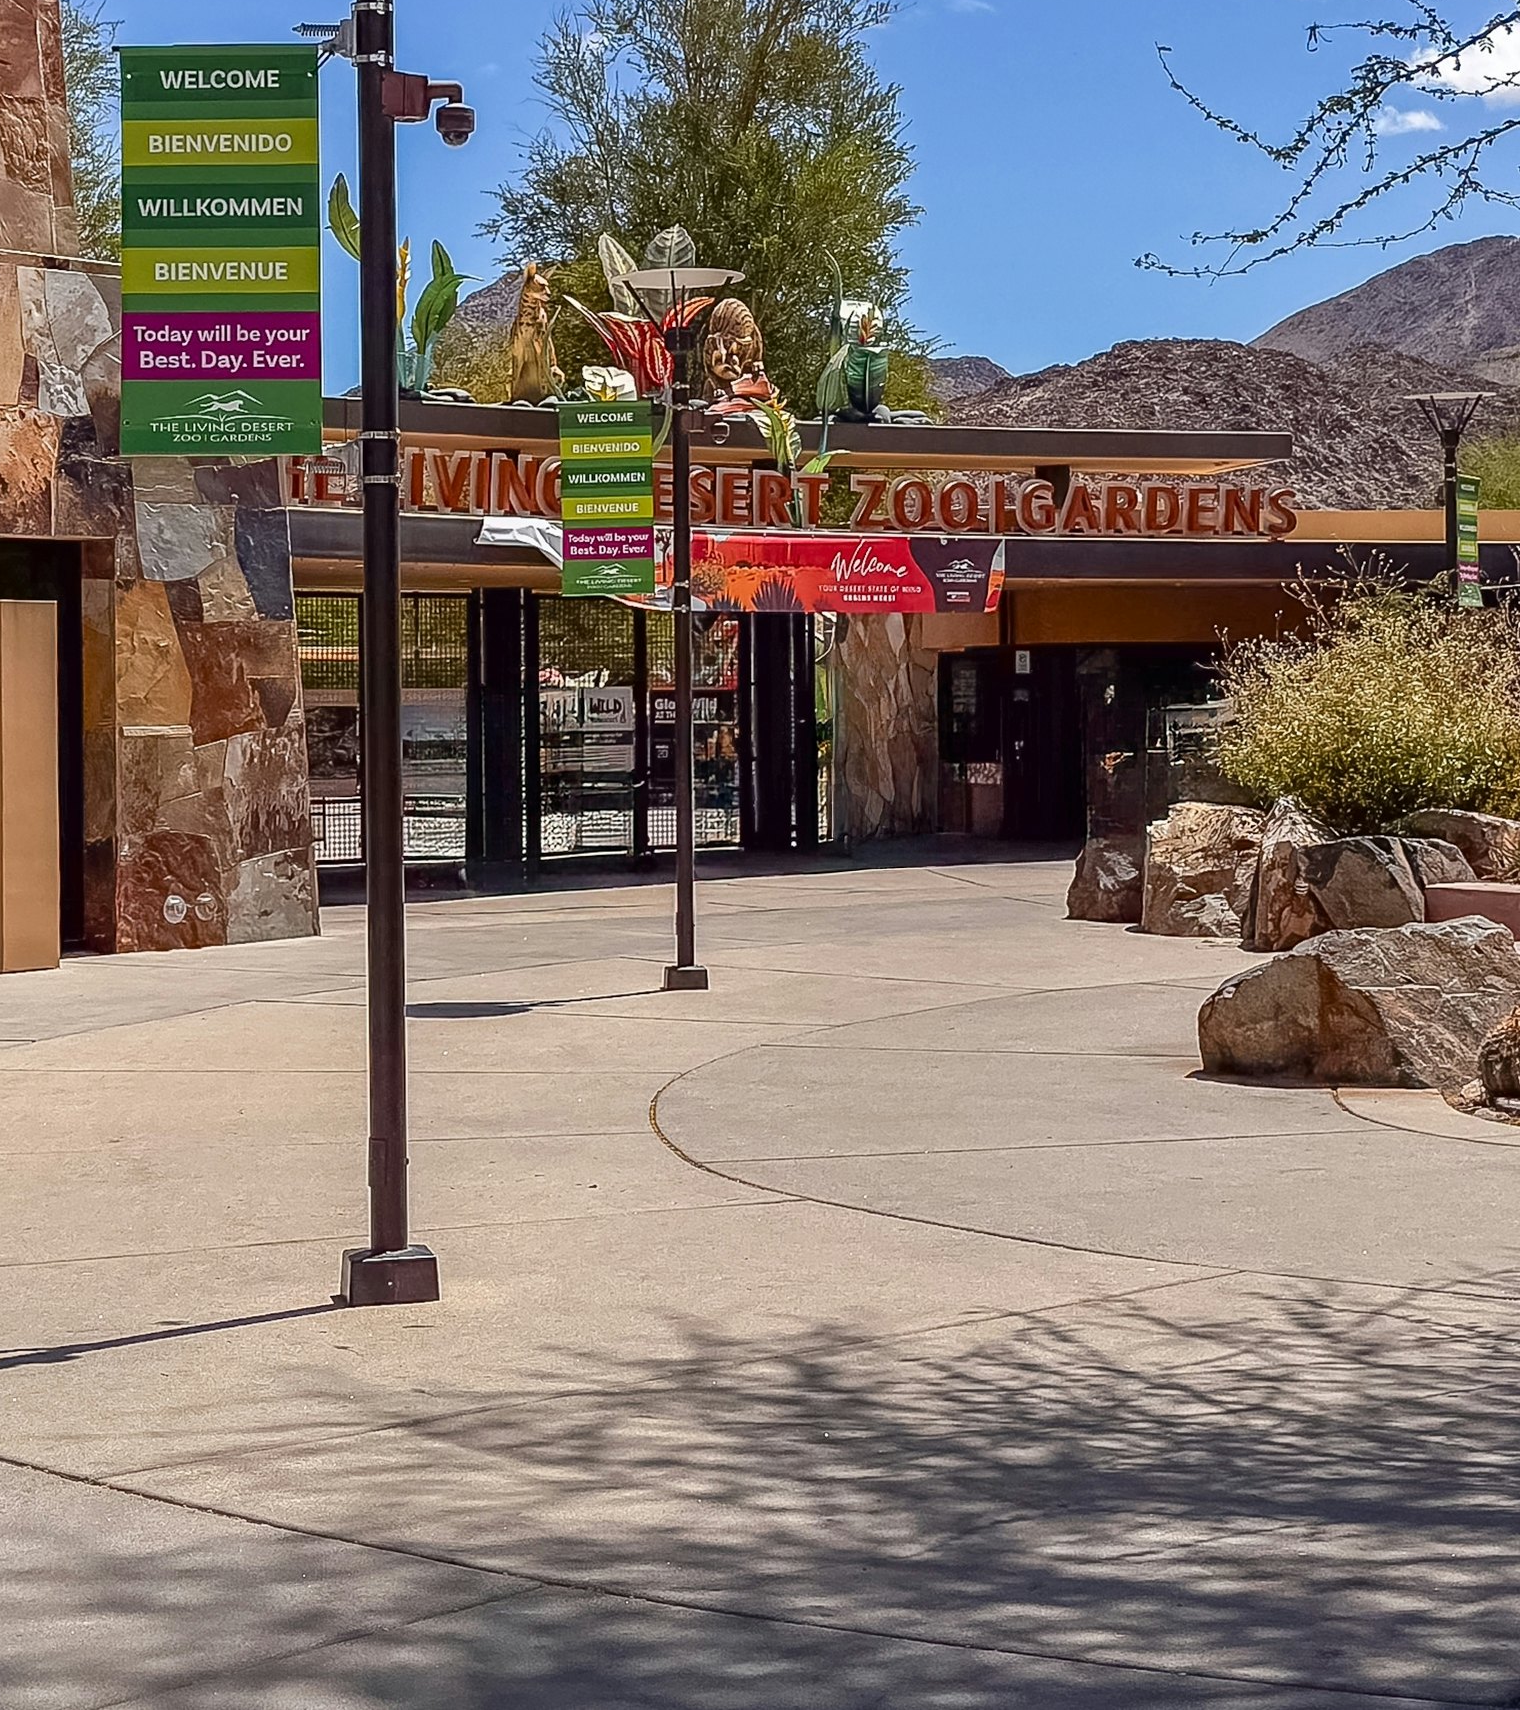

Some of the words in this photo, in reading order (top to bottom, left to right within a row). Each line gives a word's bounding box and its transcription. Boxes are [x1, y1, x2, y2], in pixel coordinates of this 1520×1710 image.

[160, 70, 279, 89] WELCOME
[148, 134, 292, 153] BIENVENIDO
[138, 197, 303, 217] WILLKOMMEN
[155, 262, 288, 281] BIENVENUE
[133, 325, 193, 346] Today
[197, 325, 231, 342] will
[236, 325, 261, 341] be
[265, 329, 310, 346] your
[139, 351, 196, 369] Best.
[201, 351, 248, 373] Day.
[252, 351, 305, 368] Ever.
[576, 412, 634, 423] WELCOME
[149, 423, 179, 432] THE
[184, 423, 236, 432] LIVING
[241, 422, 294, 431] DESERT
[173, 434, 202, 442] ZOO
[210, 433, 272, 442] GARDENS
[572, 442, 640, 454] BIENVENIDO
[568, 472, 646, 484] WILLKOMMEN
[576, 502, 639, 514] BIENVENUE
[653, 462, 829, 532] ESERT
[850, 473, 976, 533] ZOO
[1016, 480, 1298, 539] GARDENS
[568, 533, 595, 544] Today
[596, 533, 613, 542] will
[614, 532, 627, 541] be
[628, 533, 649, 543] your
[598, 545, 621, 557] Day.
[622, 544, 647, 554] Ever.
[830, 540, 909, 582] Welcome
